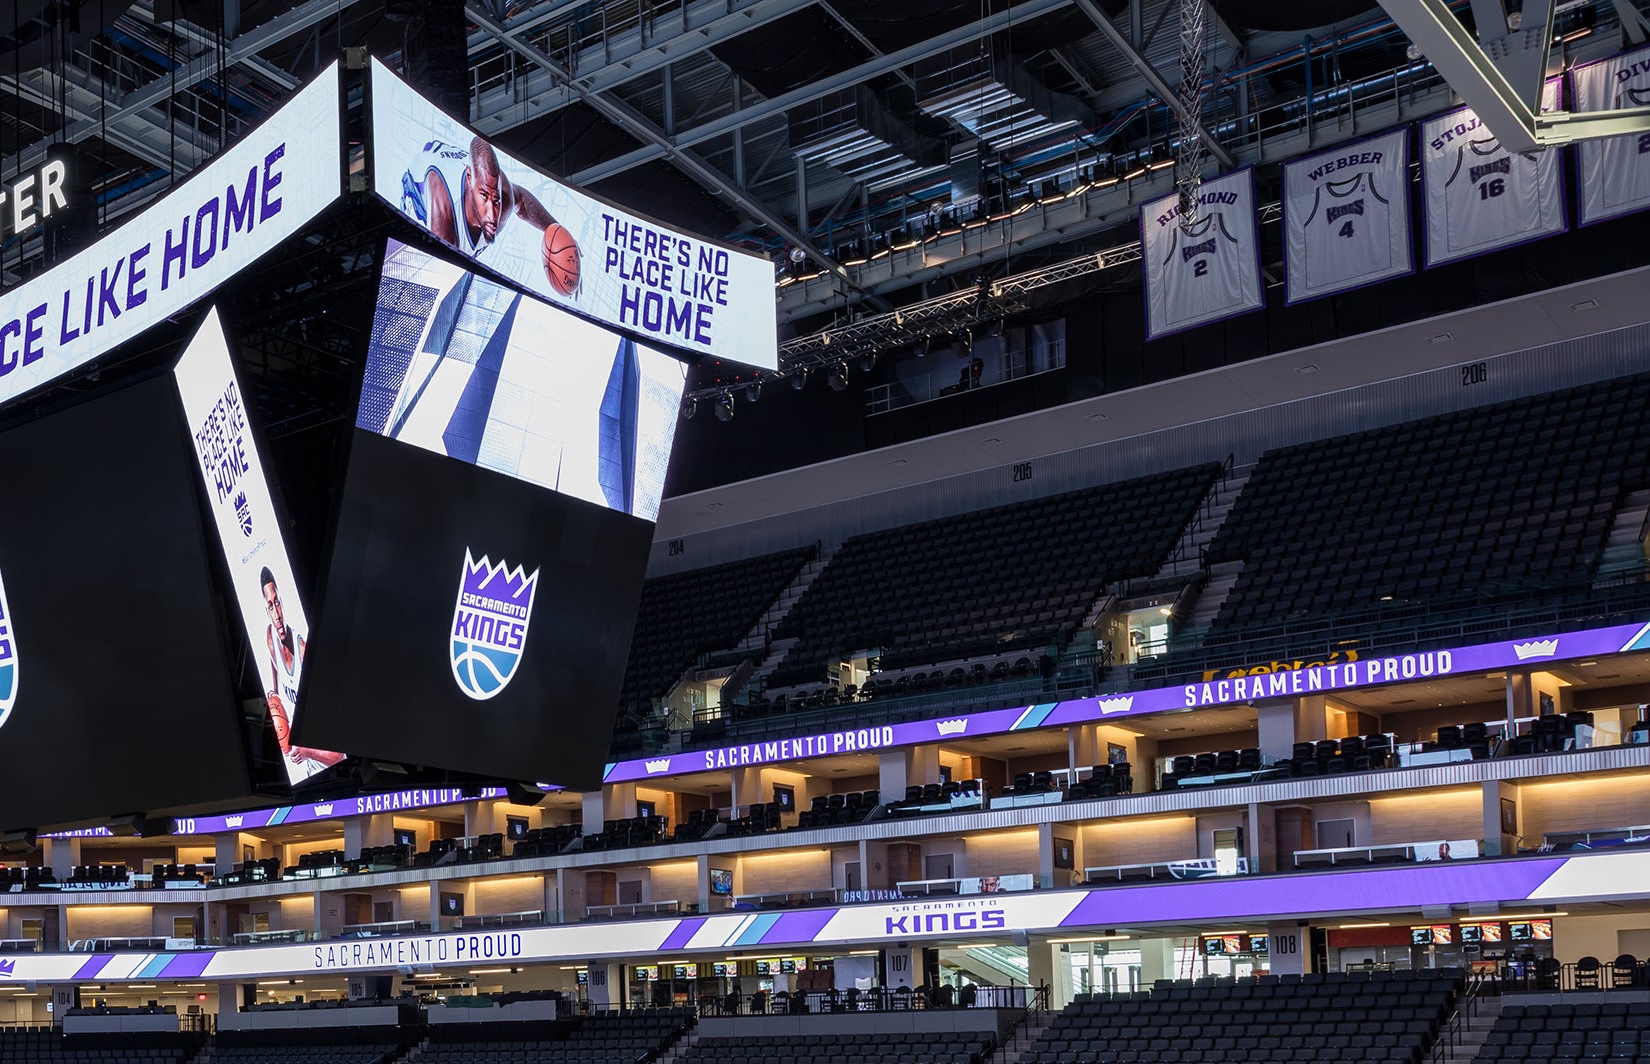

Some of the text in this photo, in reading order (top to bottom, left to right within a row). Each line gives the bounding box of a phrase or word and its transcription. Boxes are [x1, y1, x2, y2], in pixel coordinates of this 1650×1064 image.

[1308, 152, 1383, 182] WEBBER
[1478, 178, 1505, 200] 16
[1325, 198, 1365, 225] KINGS
[1338, 220, 1355, 239] 4
[59, 248, 151, 346] LIKE
[161, 142, 286, 293] HOME
[602, 213, 729, 277] THERE'S NO
[605, 246, 673, 292] PLACE
[680, 269, 728, 306] LIKE
[1193, 259, 1208, 278] 2
[619, 283, 714, 346] HOME
[1461, 362, 1487, 387] 206
[195, 380, 238, 454] THERE'S NO
[203, 404, 245, 477] PLACE LIKE
[214, 436, 249, 504] HOME
[1012, 460, 1033, 482] 205
[237, 503, 250, 524] SAC
[669, 539, 684, 556] 204
[462, 592, 527, 618] SACRAMENTO
[454, 610, 525, 650] KINGS
[1185, 663, 1356, 707] SACRAMENTO
[1367, 650, 1452, 684] PROUD
[705, 726, 893, 769] SACRAMENTO PROUD
[357, 788, 448, 813] SACRAMENTO
[892, 900, 997, 912] SACRAMENTO
[885, 909, 1005, 934] KINGS
[314, 932, 522, 968] SACRAMENTO PROUD
[1275, 935, 1296, 954] 108
[891, 955, 908, 971] 107
[350, 983, 363, 996] 105
[592, 970, 605, 986] 106
[57, 992, 71, 1004] 104
